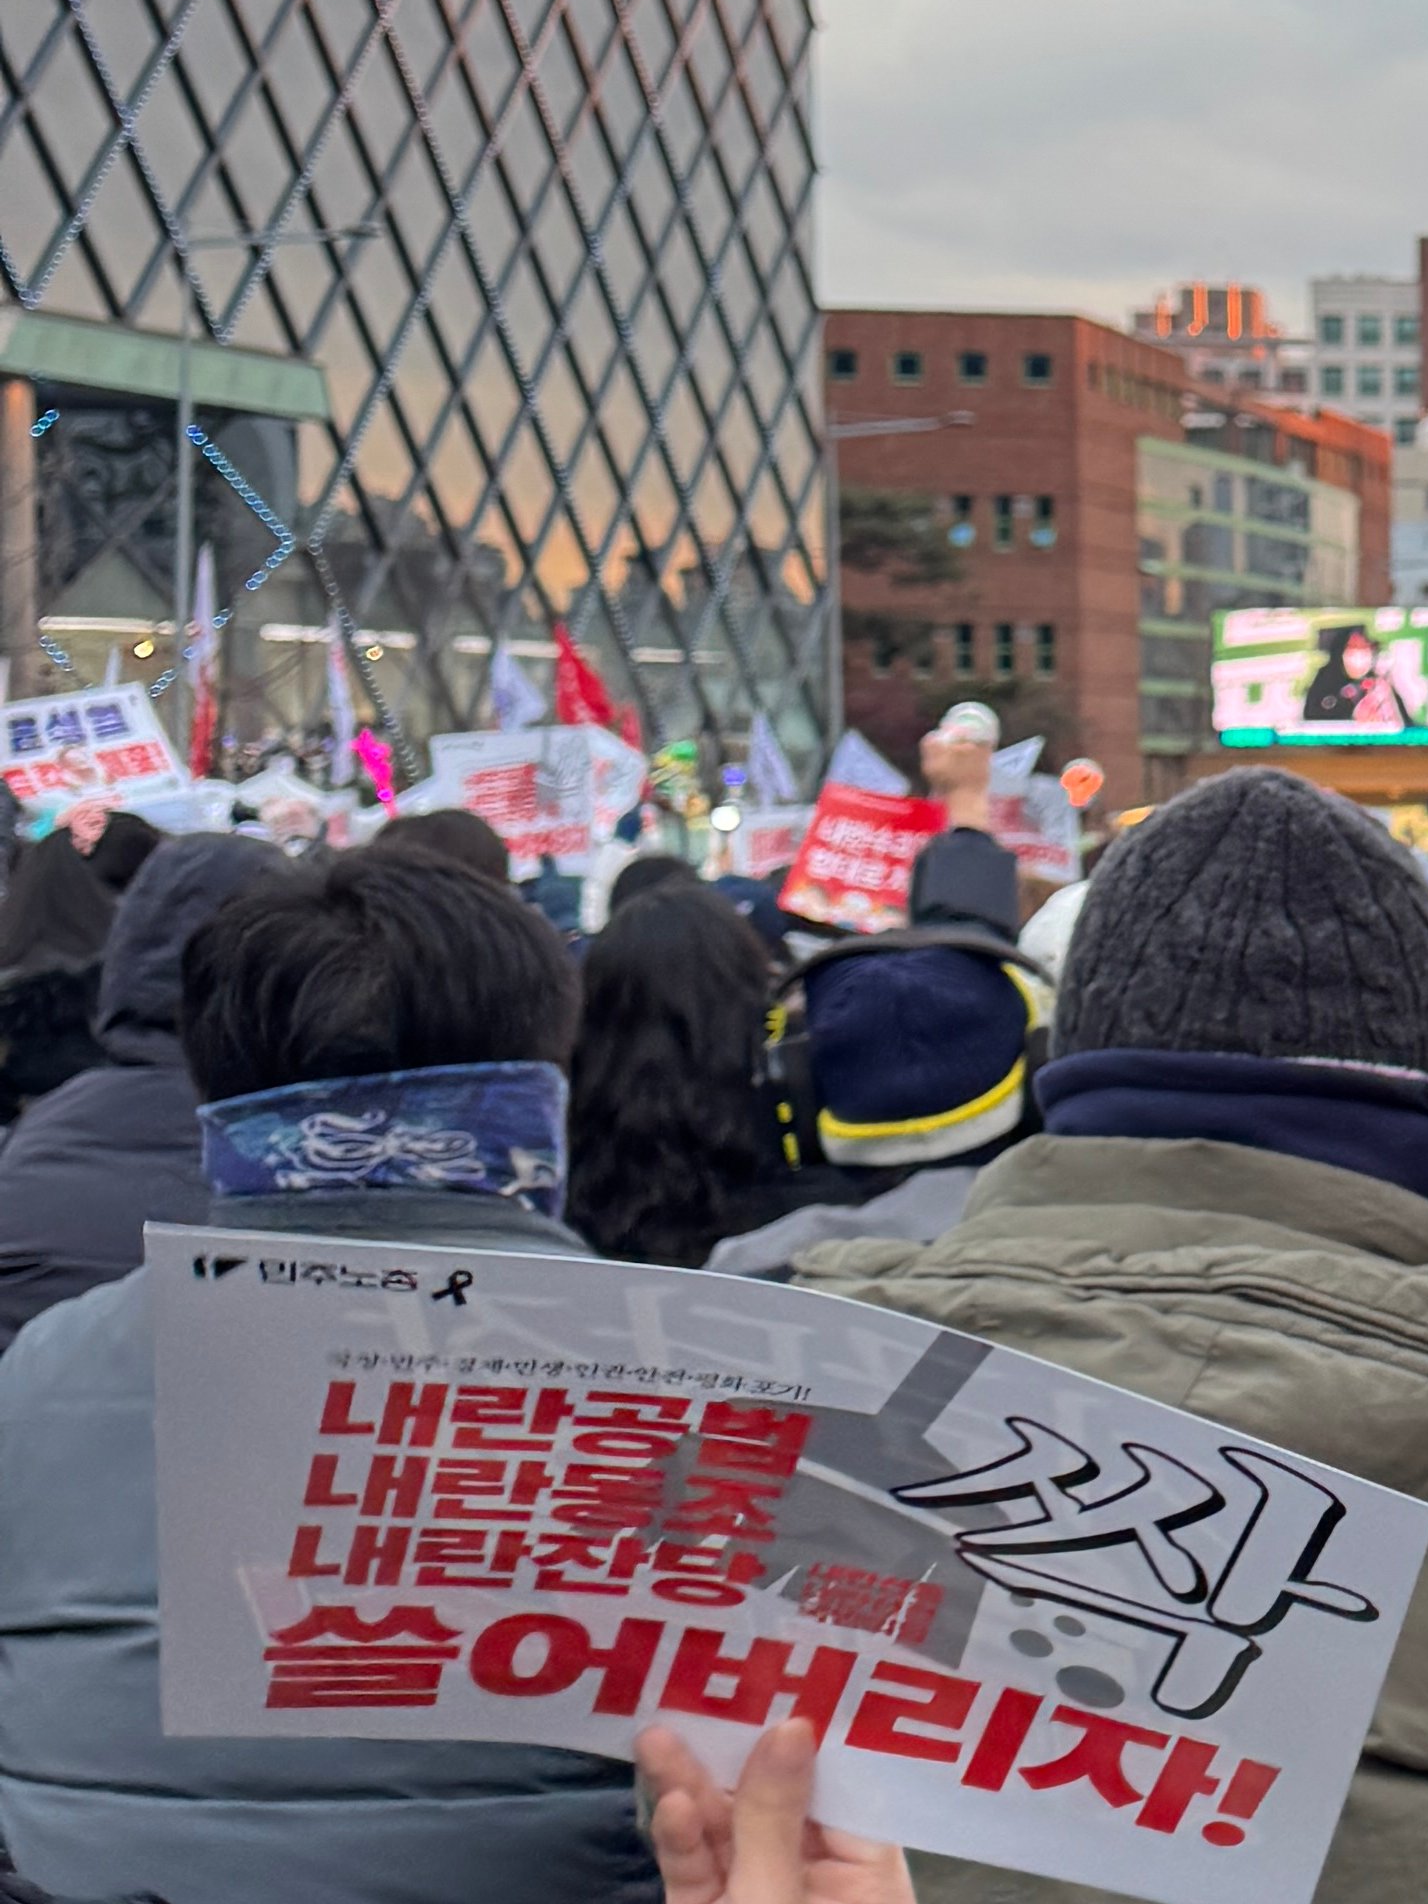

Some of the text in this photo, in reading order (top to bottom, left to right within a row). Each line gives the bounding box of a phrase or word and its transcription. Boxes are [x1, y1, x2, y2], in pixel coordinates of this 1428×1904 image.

[319, 1380, 813, 1479] 내란공범
[303, 1453, 790, 1543] 내란동조
[288, 1524, 769, 1608] 내란잔당
[263, 1604, 1283, 1847] 쓸어버리자!
